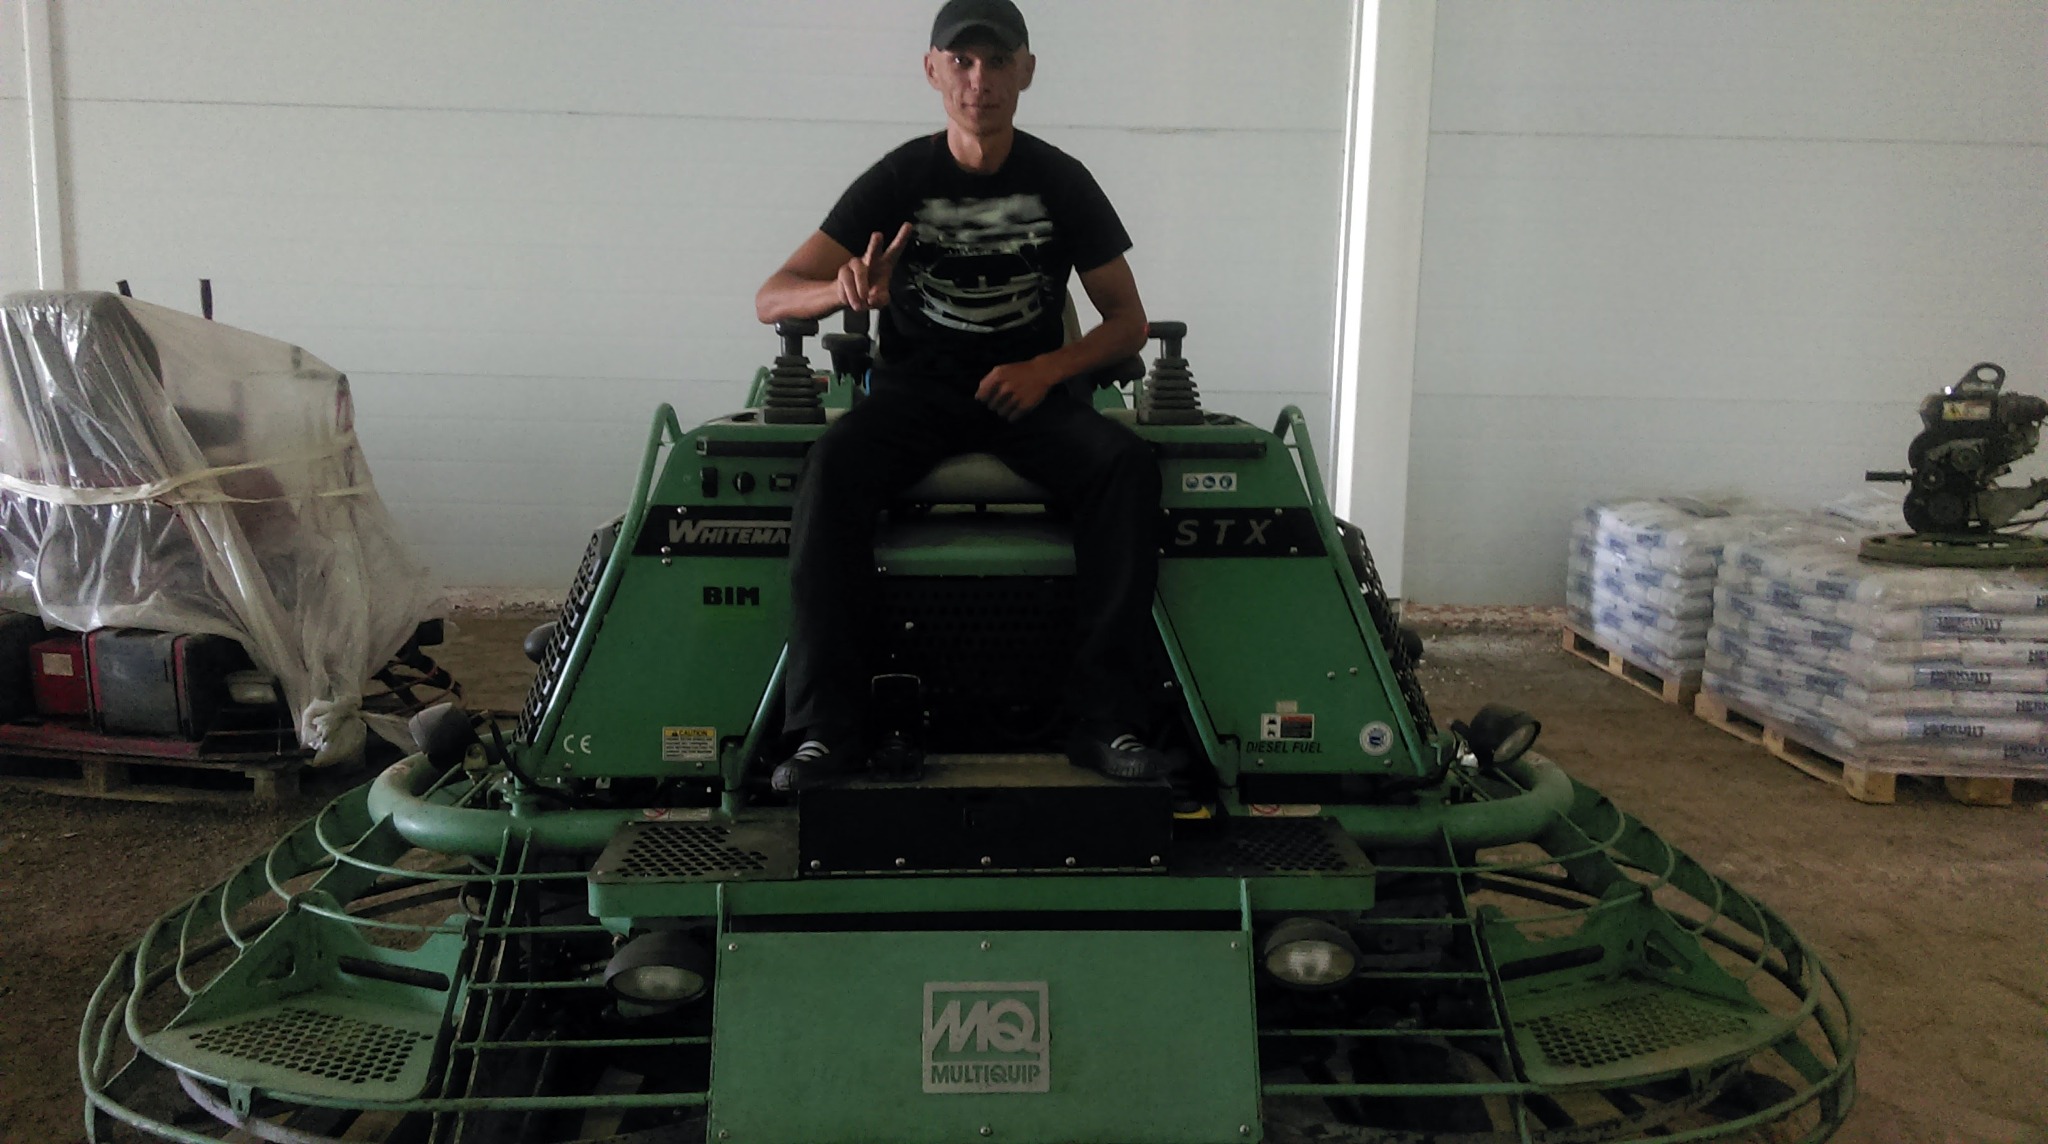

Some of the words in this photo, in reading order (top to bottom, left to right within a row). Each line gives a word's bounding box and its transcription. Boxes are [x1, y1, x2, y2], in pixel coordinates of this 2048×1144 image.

[668, 519, 792, 544] WHITEMA
[703, 586, 760, 606] BIM
[679, 729, 708, 737] CAUTION
[563, 734, 592, 754] CE
[1246, 741, 1289, 754] DIESEL
[1292, 741, 1324, 754] FUEL
[927, 998, 1043, 1053] MQ
[931, 1064, 1042, 1085] MULTIQUIP
